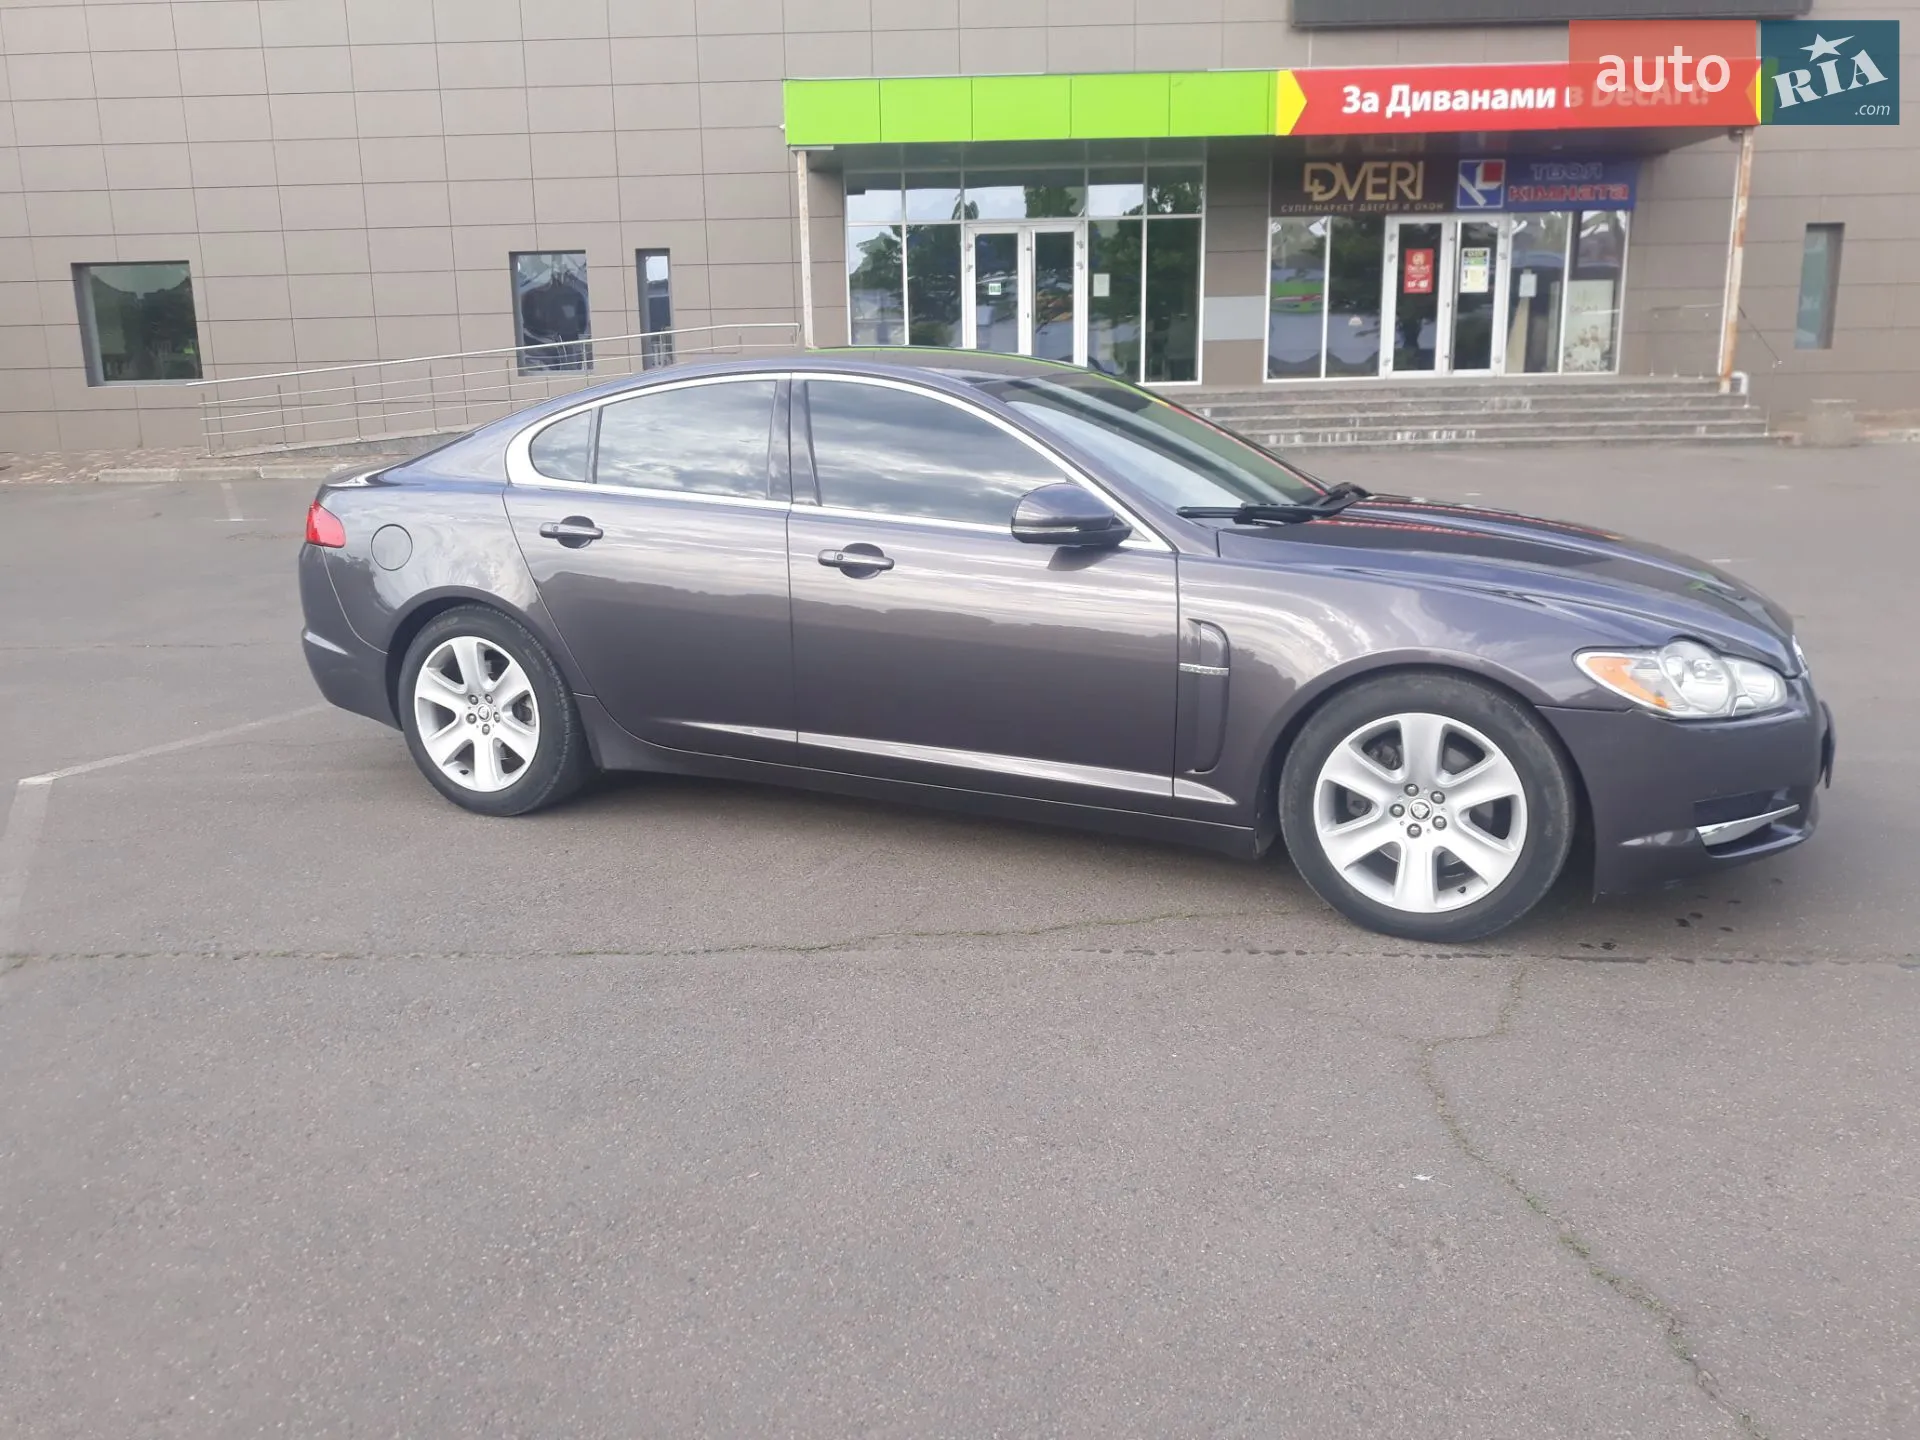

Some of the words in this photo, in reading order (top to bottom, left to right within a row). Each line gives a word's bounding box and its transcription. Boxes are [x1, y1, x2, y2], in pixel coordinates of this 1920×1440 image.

[1342, 84, 1379, 114] За
[1385, 83, 1556, 119] Диванами
[1563, 86, 1584, 108] в
[1303, 161, 1424, 202] DVERI
[1529, 162, 1603, 180] ТВОЯ
[1281, 203, 1354, 213] СУПЕРМАРКЕТ
